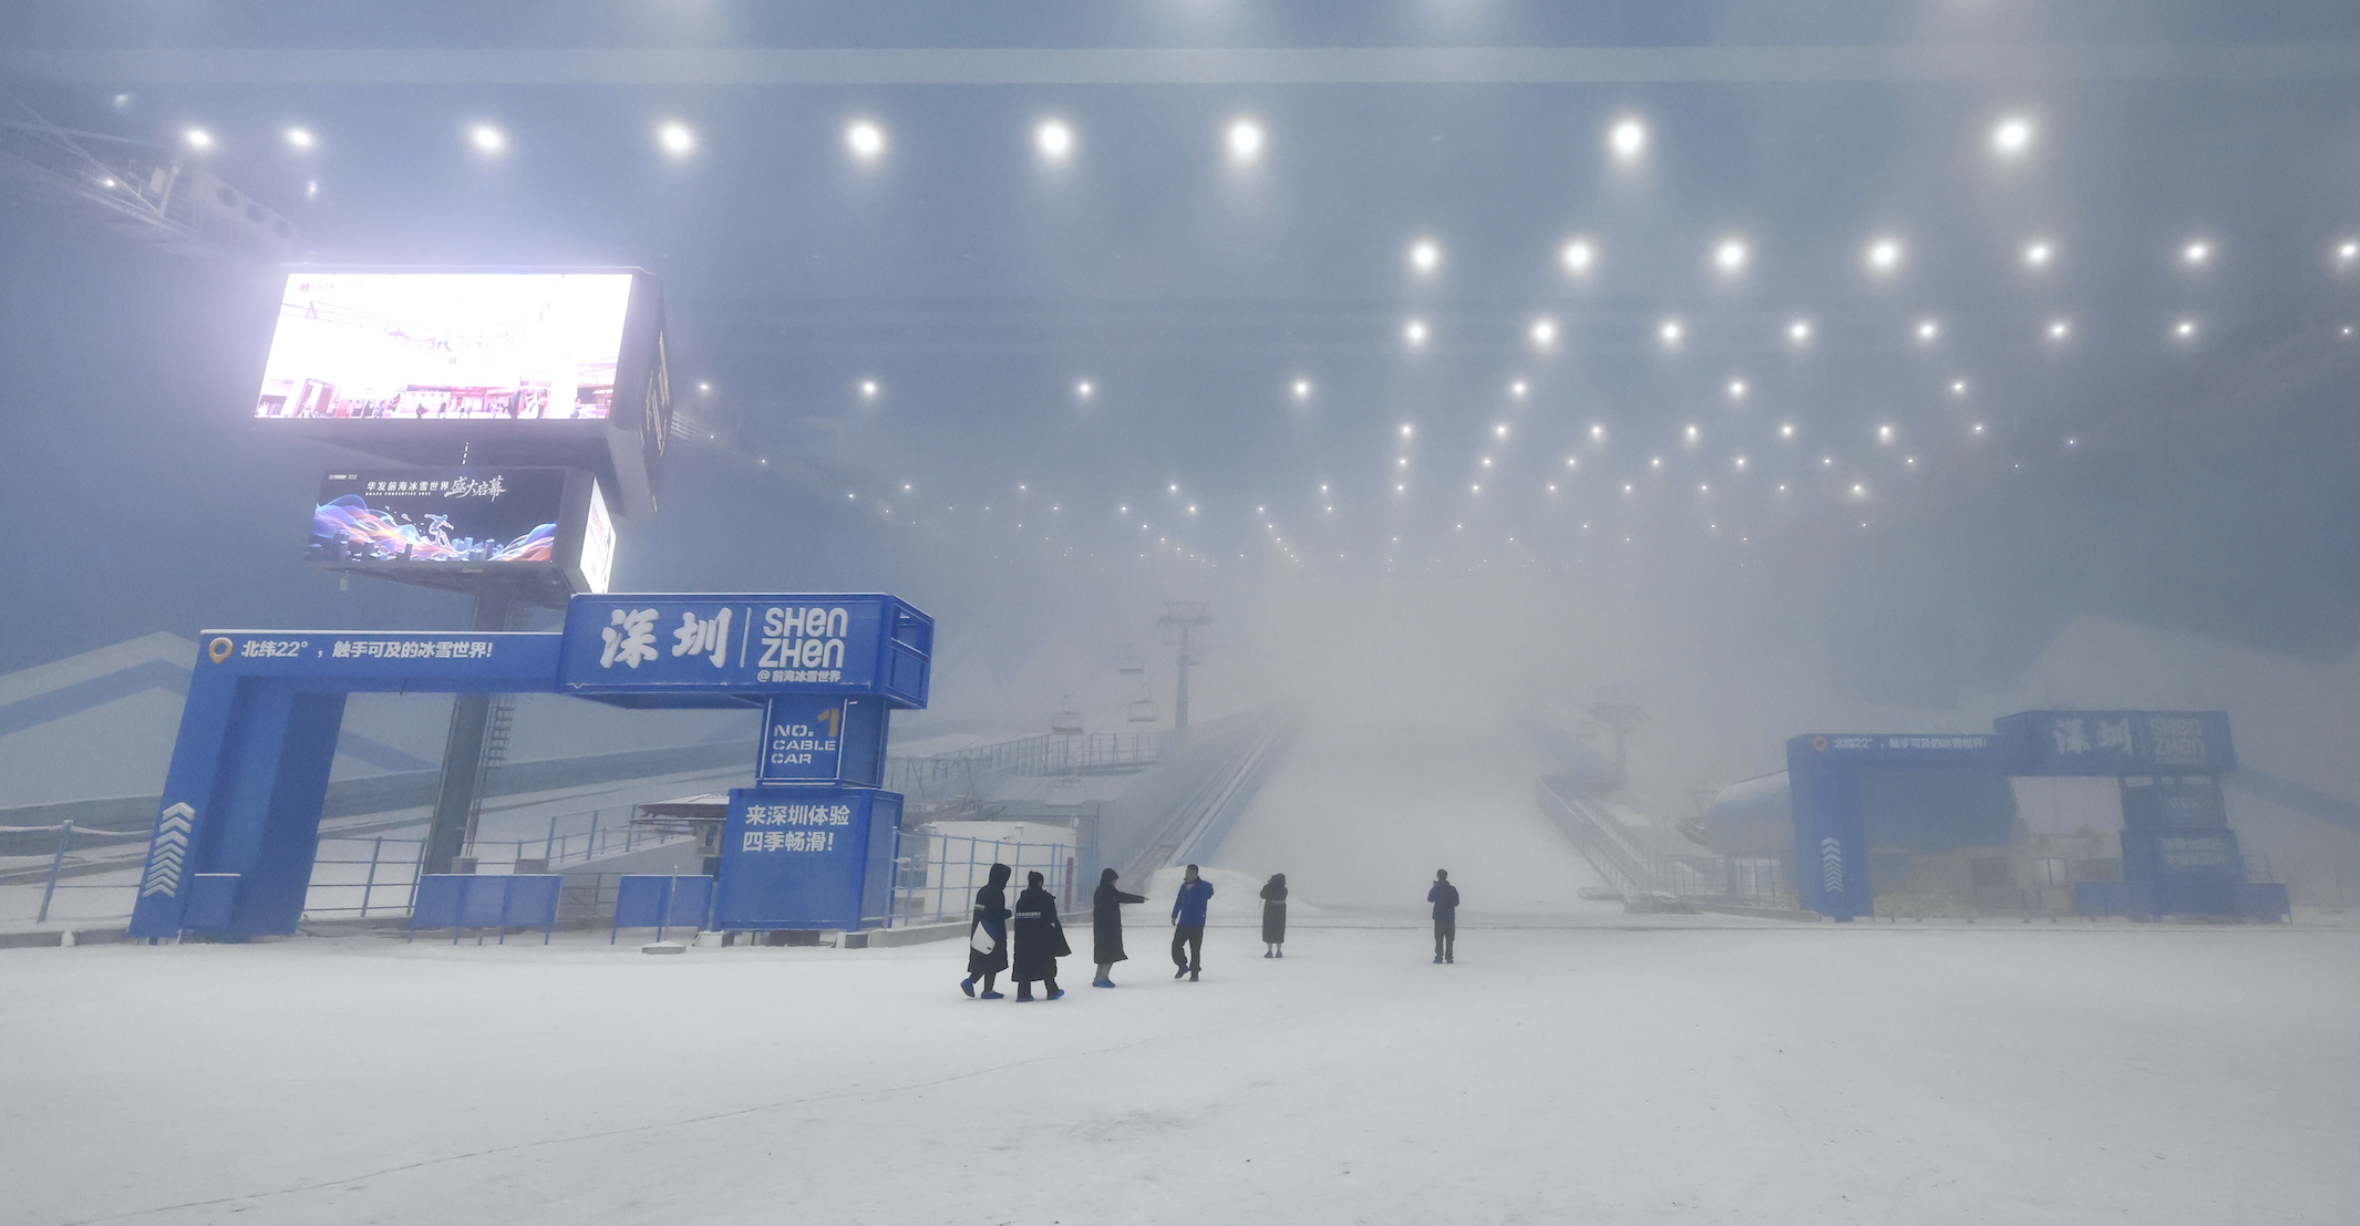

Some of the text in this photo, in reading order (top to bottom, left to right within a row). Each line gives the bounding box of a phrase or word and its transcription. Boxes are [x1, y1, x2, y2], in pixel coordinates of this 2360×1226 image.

[366, 474, 507, 502] 华发前海冰雪世界 盛大启幕
[599, 607, 733, 669] 深圳
[773, 708, 840, 738] NO. 1
[772, 739, 837, 752] CABLE
[770, 753, 812, 765] CAR
[745, 804, 851, 827] 来深圳体验
[741, 830, 835, 853] 四季畅滑!
